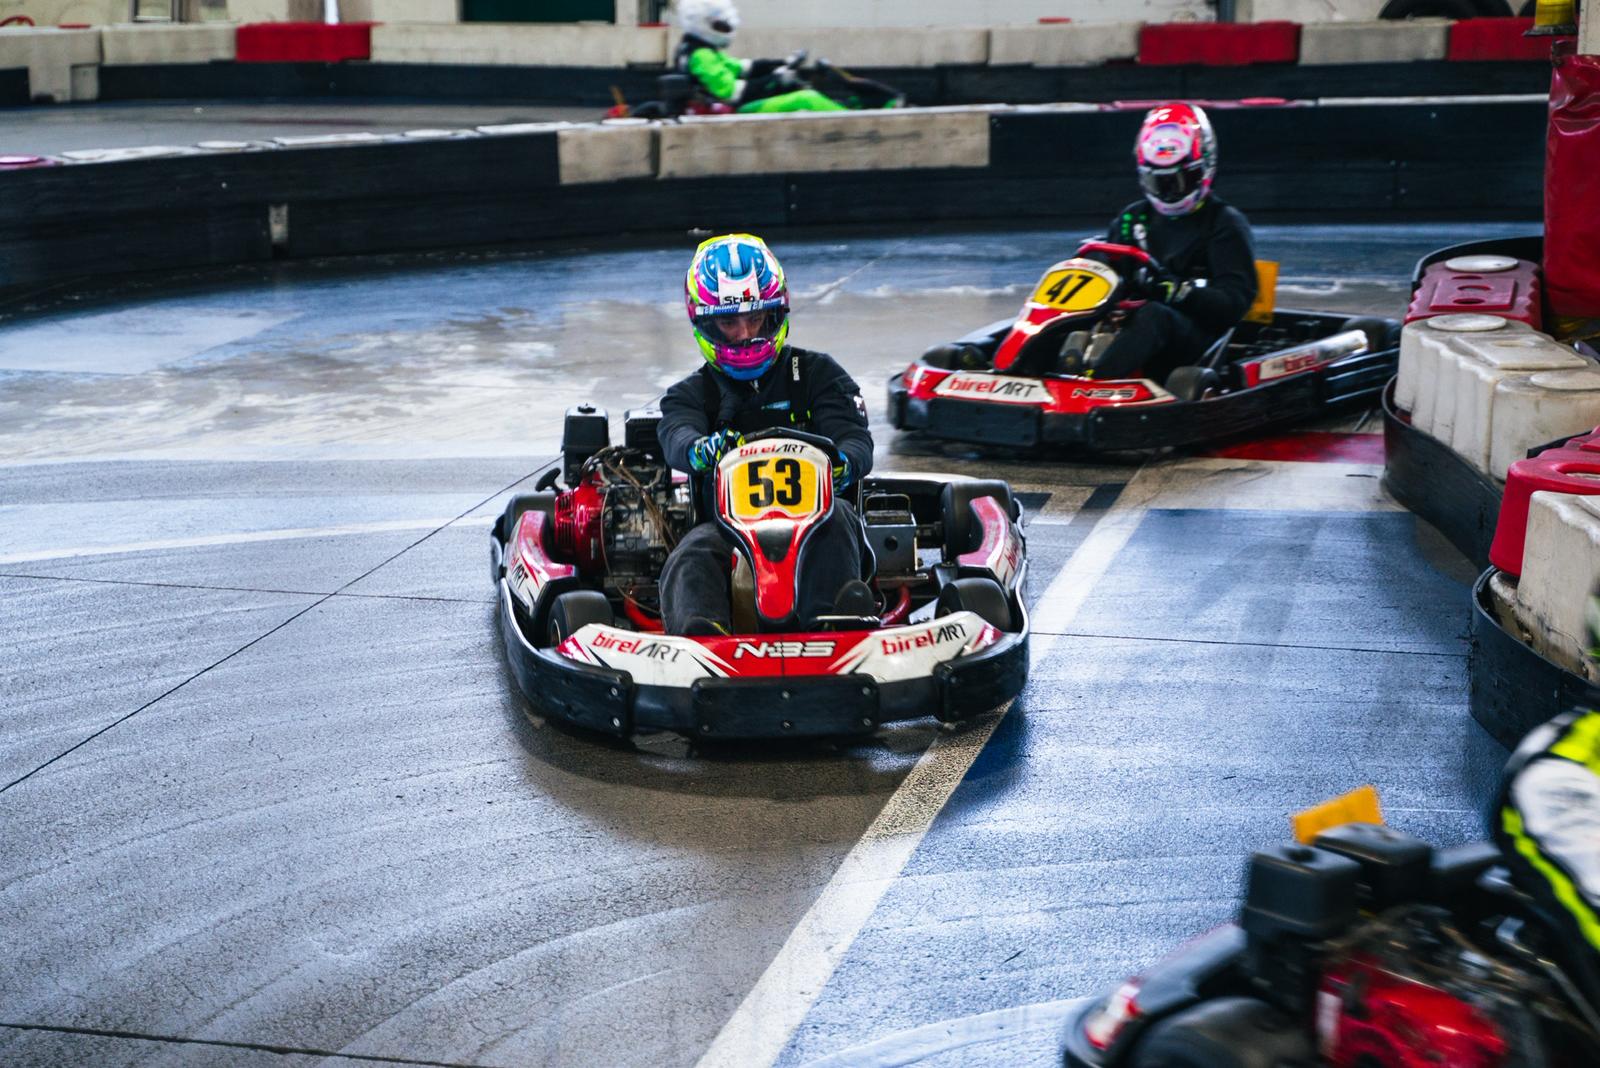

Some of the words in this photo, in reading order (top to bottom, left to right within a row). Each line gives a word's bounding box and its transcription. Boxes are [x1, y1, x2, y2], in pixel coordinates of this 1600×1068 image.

[1045, 273, 1095, 304] 47
[949, 376, 1040, 398] birelART
[739, 443, 808, 457] birelART
[748, 457, 802, 508] 53
[591, 631, 688, 665] birelART
[880, 622, 967, 656] birelART
